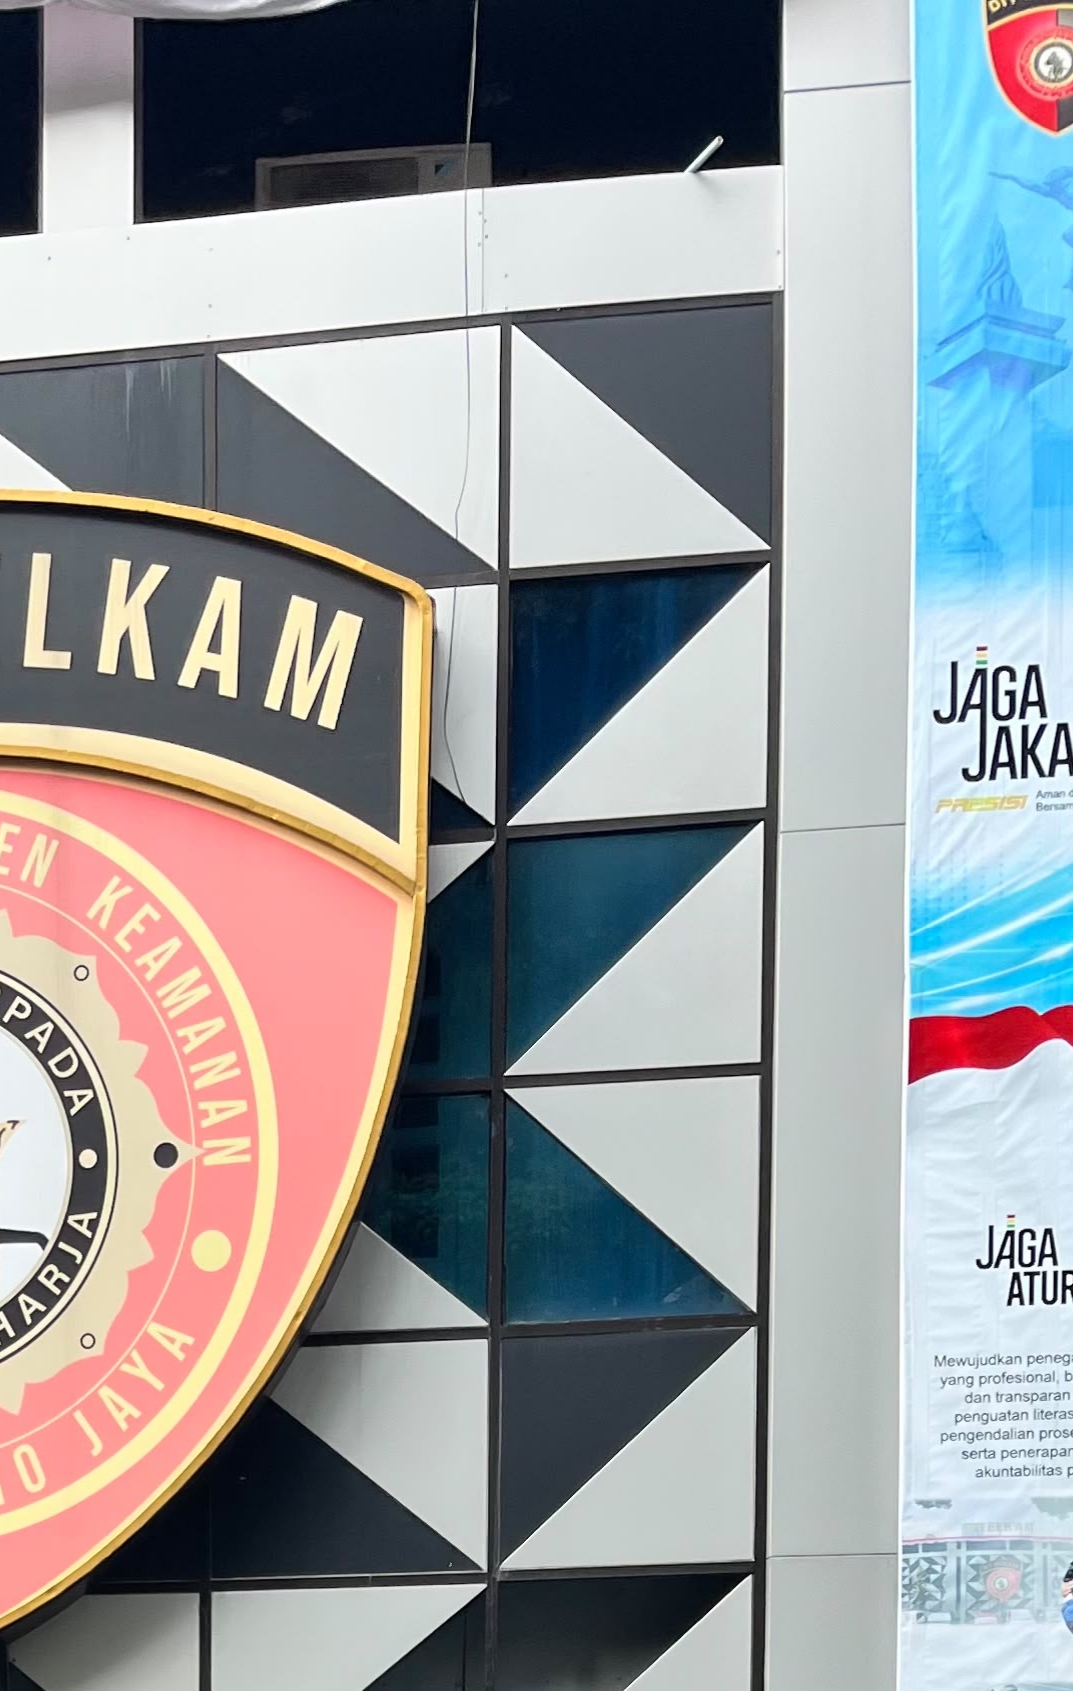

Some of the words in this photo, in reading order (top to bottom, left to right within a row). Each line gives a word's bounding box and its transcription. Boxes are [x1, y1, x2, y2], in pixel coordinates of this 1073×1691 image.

[933, 661, 1048, 724] JAGA
[1036, 790, 1065, 799] Aman
[86, 876, 253, 1168] KEAMANAN
[975, 1225, 1058, 1270] JAGA
[934, 1354, 1022, 1369] Mewujudkan
[940, 1375, 974, 1389] yang
[979, 1371, 1060, 1387] profesional,
[85, 1322, 197, 1457] JAYA
[964, 1392, 991, 1403] dan
[996, 1390, 1070, 1404] transparan
[954, 1409, 1029, 1425] penguatan
[940, 1427, 1035, 1444] pengendalian
[961, 1448, 996, 1460] serta
[975, 1464, 1063, 1478] akuntabilitas
